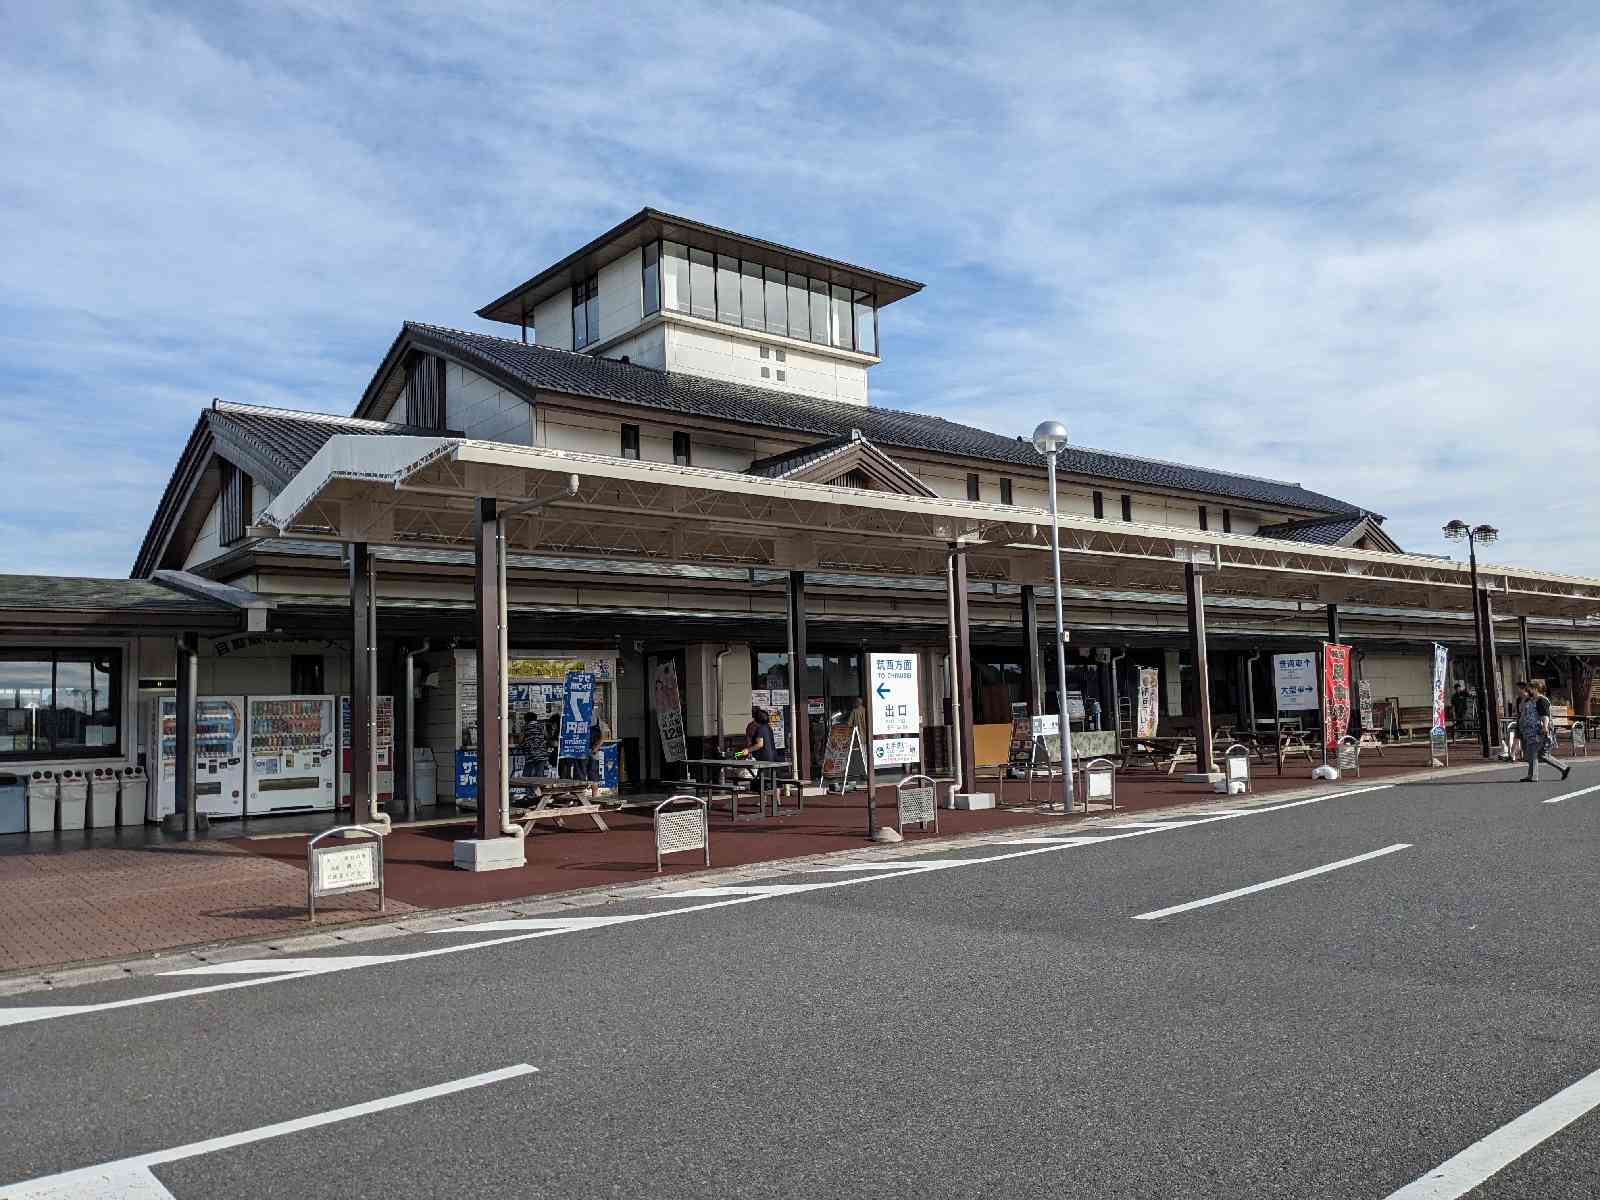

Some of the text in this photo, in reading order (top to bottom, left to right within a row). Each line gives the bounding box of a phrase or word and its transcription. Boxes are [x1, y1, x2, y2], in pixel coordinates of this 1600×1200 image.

[877, 660, 912, 671] 筑西方面
[885, 704, 908, 717] 出口
